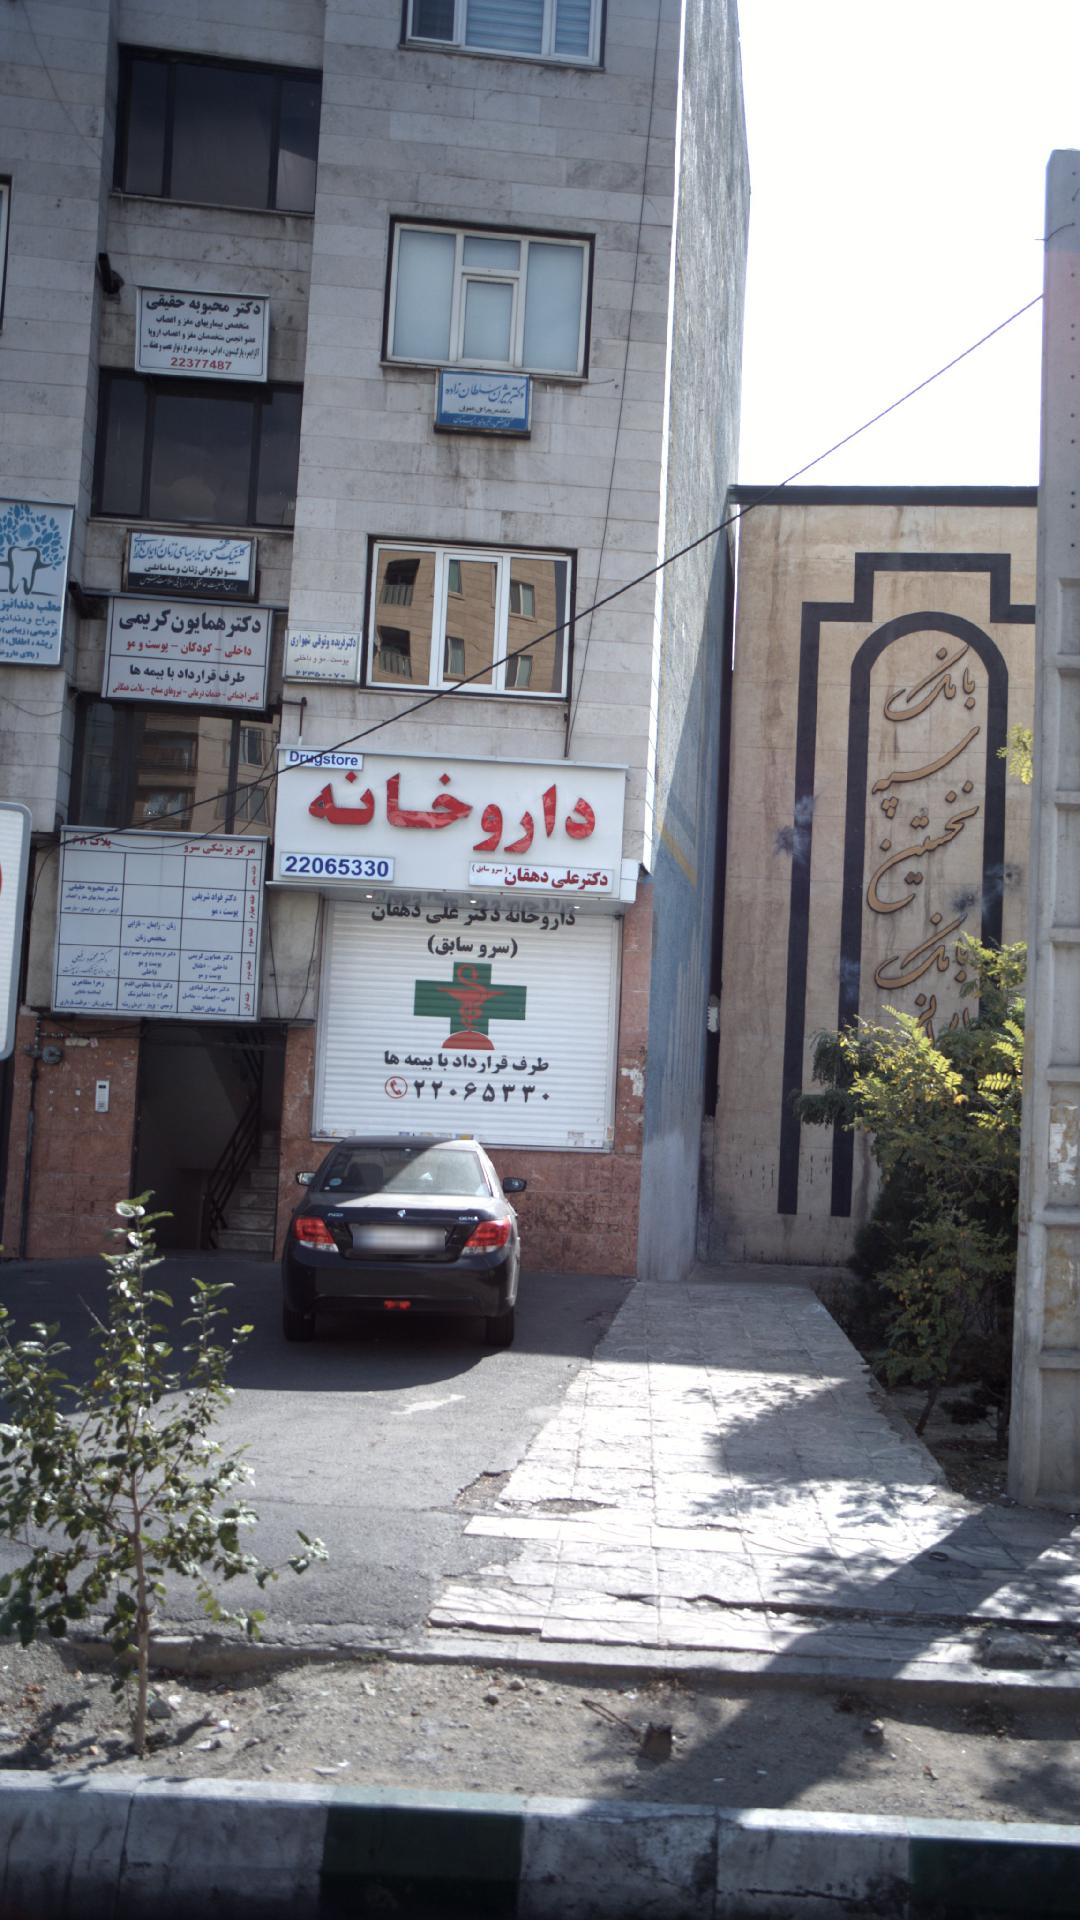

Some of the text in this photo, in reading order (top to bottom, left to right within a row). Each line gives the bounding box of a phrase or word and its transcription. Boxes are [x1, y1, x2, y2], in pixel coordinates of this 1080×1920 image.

[146, 294, 261, 317] دکتر محبوبه حقیقی
[156, 315, 176, 323] اعصاب
[225, 321, 249, 330] متخصص
[170, 357, 232, 370] 22377487
[458, 384, 503, 399] سلطان
[181, 565, 197, 575] زنان
[198, 565, 237, 578] سونوگرافی
[0, 598, 61, 613] مطب دندانپز
[119, 609, 261, 637] دکتر همایون کریمی
[127, 641, 136, 651] مو
[145, 640, 168, 653] پوست
[180, 642, 212, 656] کودکان
[225, 645, 252, 658] داخلی
[130, 664, 141, 676] ها
[143, 668, 164, 680] بیمه
[167, 667, 175, 680] با
[219, 672, 245, 686] طرف
[884, 643, 976, 722] بانک
[289, 751, 358, 766] Drugstore
[308, 770, 595, 854] داروخانه
[184, 843, 255, 856] مرکز پزشکی سرو
[285, 856, 389, 878] 22065330
[504, 867, 608, 890] دکتر علی دهقان
[371, 903, 575, 930] داروخانه دکتر علی دهقان
[427, 934, 518, 958] (سرو سابق)
[384, 1050, 400, 1065] ها
[404, 1054, 433, 1071] بیمه
[437, 1053, 449, 1071] با
[512, 1056, 549, 1075] طرف
[413, 1079, 550, 1103] ۲۲۰۶۵۳۳۰
